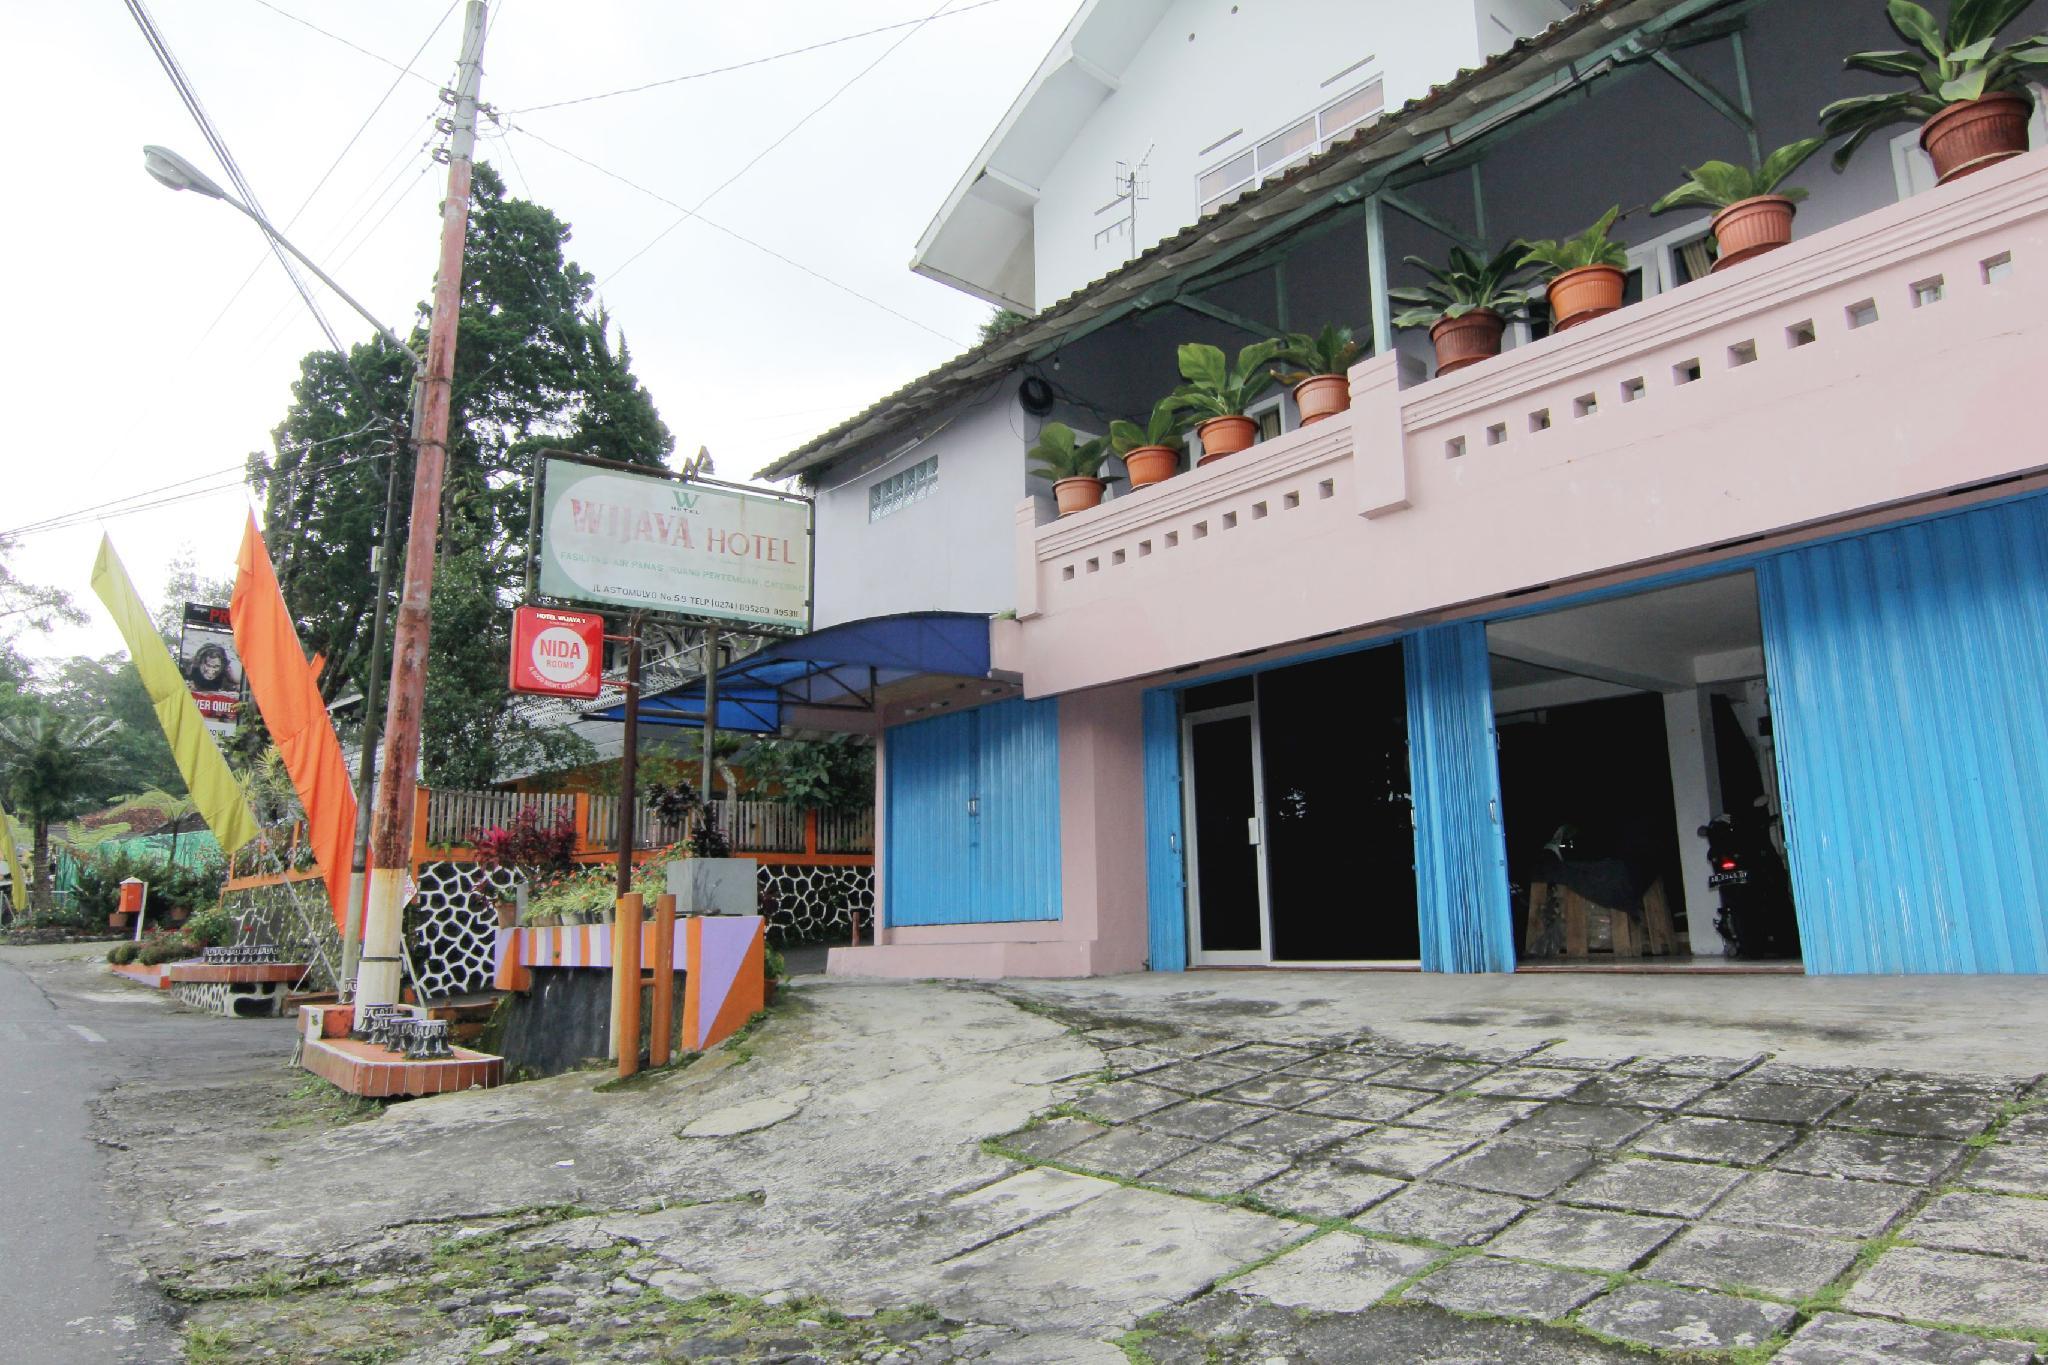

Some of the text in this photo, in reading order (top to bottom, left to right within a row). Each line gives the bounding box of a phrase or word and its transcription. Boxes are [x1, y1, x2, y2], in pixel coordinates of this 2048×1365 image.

[571, 498, 797, 564] WIJAYA HOTEL
[539, 639, 581, 659] NIDA
[546, 659, 575, 669] ROOMS
